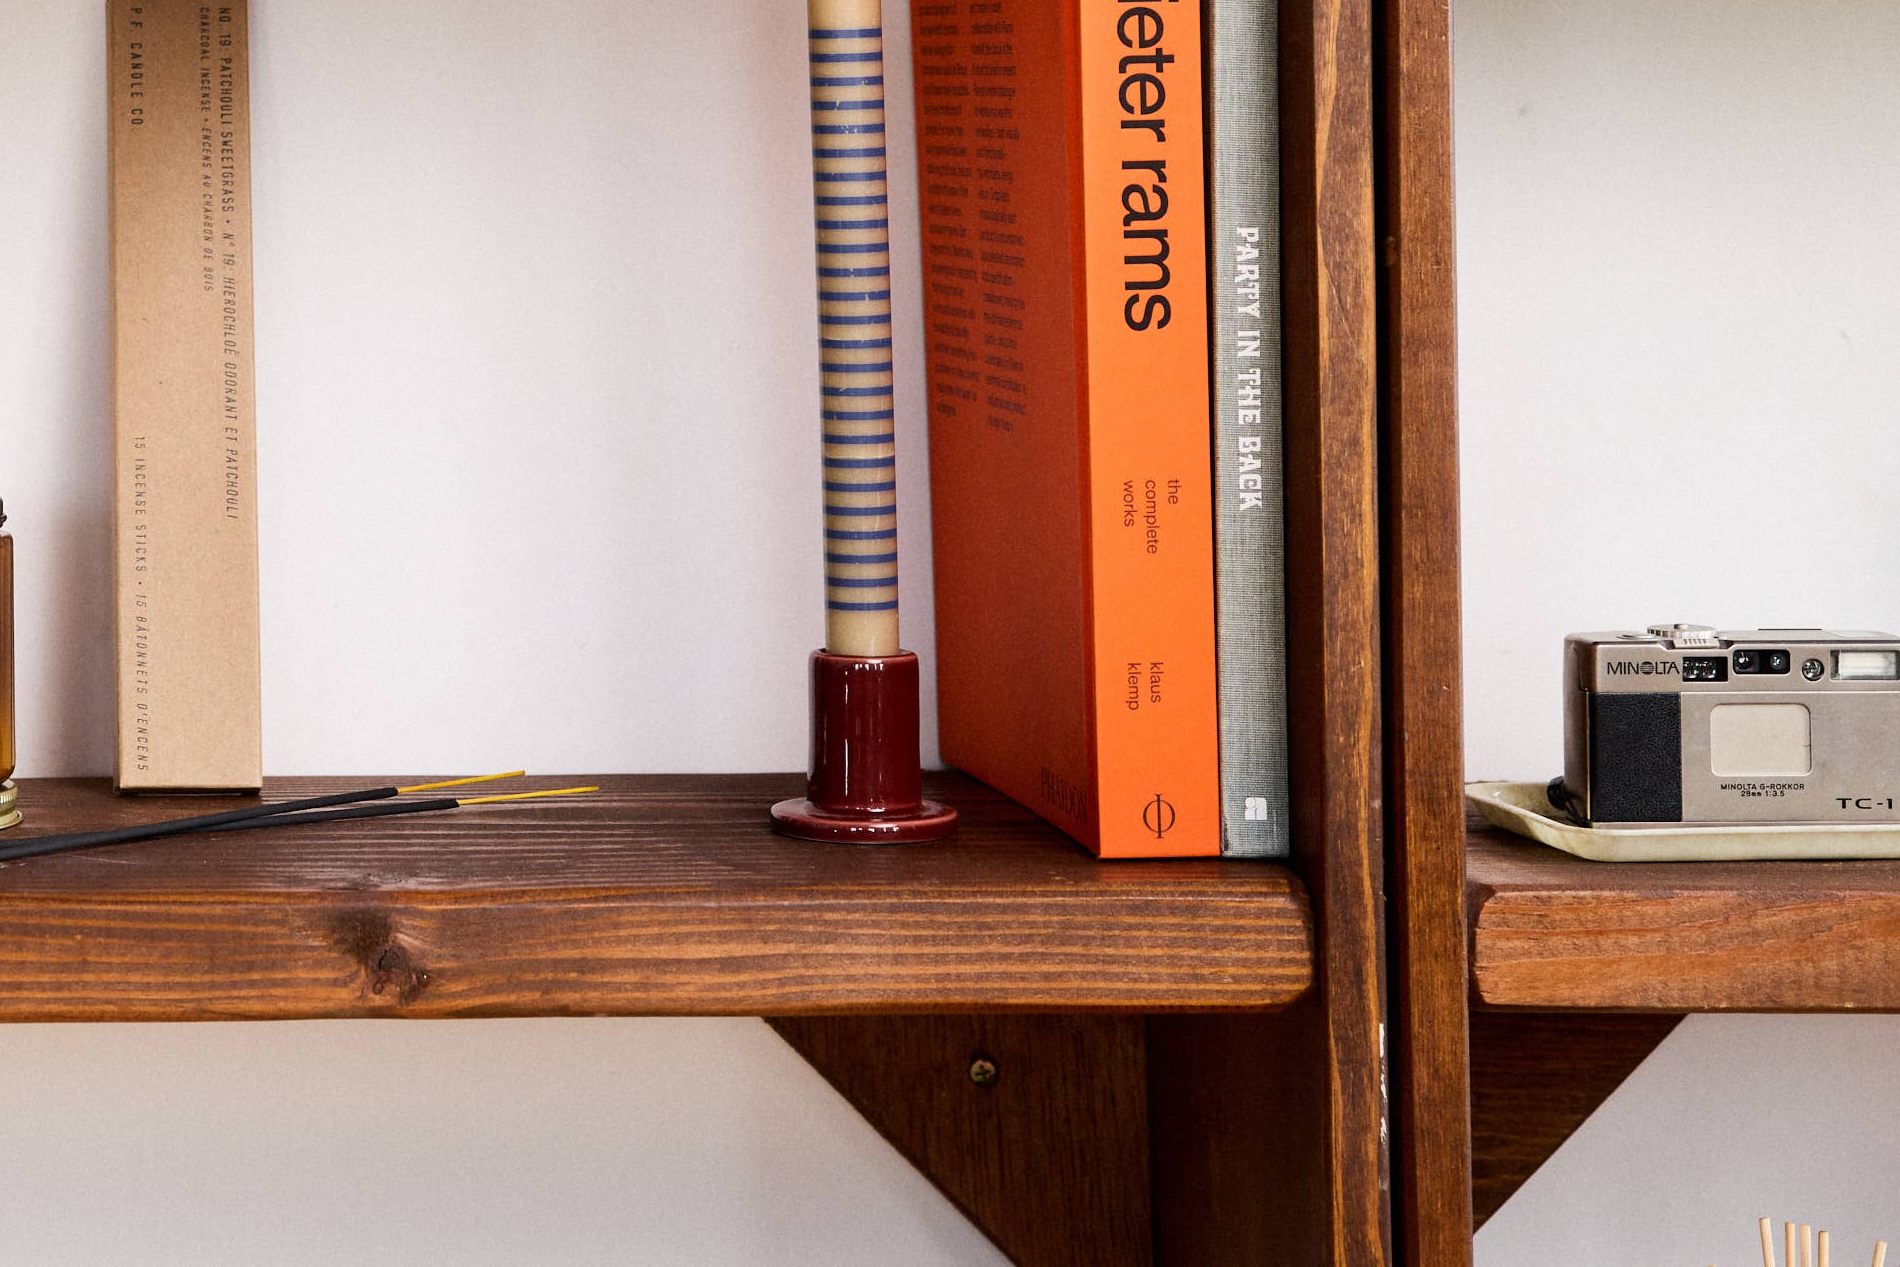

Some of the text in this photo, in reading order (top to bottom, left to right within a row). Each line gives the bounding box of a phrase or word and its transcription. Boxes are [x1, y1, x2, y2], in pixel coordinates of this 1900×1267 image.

[219, 7, 231, 27] NO.
[131, 42, 143, 98] CANDLE
[219, 57, 233, 125] PATCHOULI
[199, 7, 214, 292] CHARCOAL INCENSE ENCENS AU CHARBON DE BOIS
[220, 132, 234, 212] SWEETGRASS
[1120, 159, 1172, 331] rams
[224, 363, 238, 420] ODORANT
[1236, 226, 1262, 511] PARTY IN THE BACK
[135, 436, 146, 449] 15
[225, 428, 238, 442] ET
[135, 458, 147, 515] INCENSE
[226, 448, 238, 519] PATCHOULI
[1123, 480, 1135, 528] works
[1167, 479, 1179, 505] the
[1144, 479, 1158, 555] complete
[136, 524, 147, 572] STICKS
[136, 595, 147, 607] 15
[136, 616, 149, 694] BÂTONNETS
[1606, 660, 1680, 675] MINOLTA
[1127, 662, 1139, 711] klemp
[1150, 662, 1162, 703] klaus
[1836, 797, 1893, 809] TC-1
